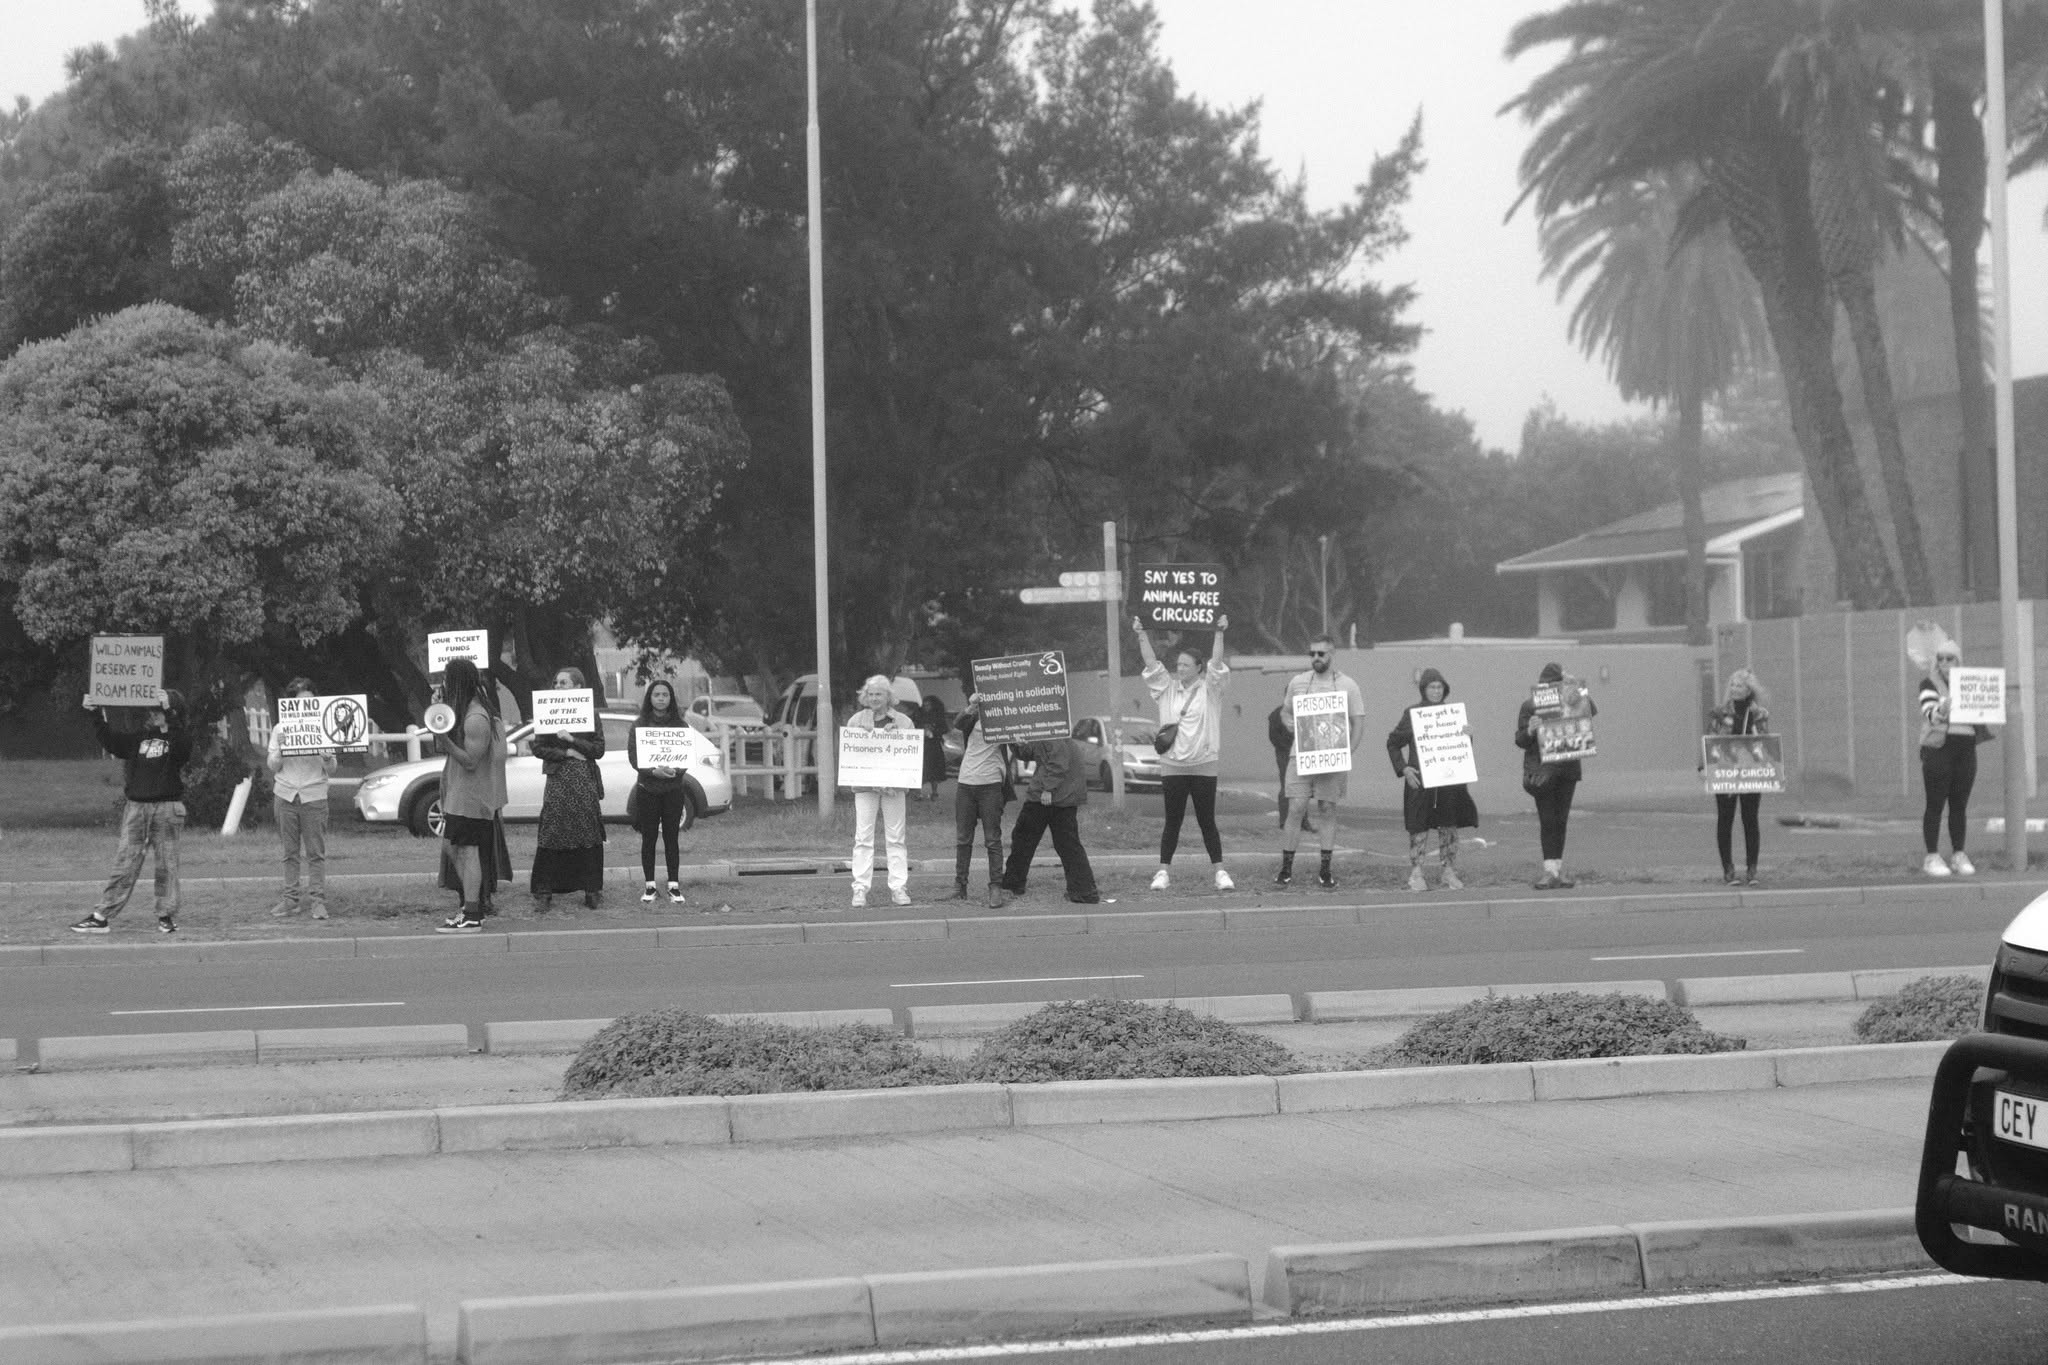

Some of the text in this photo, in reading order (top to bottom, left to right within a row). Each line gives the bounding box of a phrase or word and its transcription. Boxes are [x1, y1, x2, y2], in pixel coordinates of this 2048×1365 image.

[1144, 570, 1218, 586] SAY YES TO
[1143, 590, 1220, 606] ANIMAL-FREE
[1152, 607, 1214, 624] CIRCUSES
[96, 644, 162, 659] WILD ANIMALS
[96, 662, 154, 678] DESERVE TO
[96, 682, 156, 699] ROAM FREE
[979, 685, 1065, 702] Standing in solidarity
[1960, 684, 1976, 692] NOT
[280, 699, 320, 712] SAY NO
[985, 702, 1061, 718] with the voiceless.
[1297, 695, 1344, 712] PRISONER
[1417, 710, 1432, 718] You
[1435, 708, 1448, 719] get
[540, 717, 588, 725] VOICELESS
[1436, 720, 1457, 728] home
[283, 724, 320, 734] McLAREN
[843, 729, 868, 739] Circus
[871, 730, 904, 740] Animals
[284, 734, 322, 746] CIRCUS
[1437, 741, 1468, 751] animals
[844, 743, 918, 756] Prisoners 4 profit!
[649, 754, 688, 762] TRAUMA
[1300, 752, 1347, 769] FOR PROFIT
[1424, 756, 1436, 767] get
[1715, 768, 1776, 778] STOP CIRCUS
[1712, 780, 1780, 790] WITH ANIMALS
[2002, 1098, 2037, 1140] CEY
